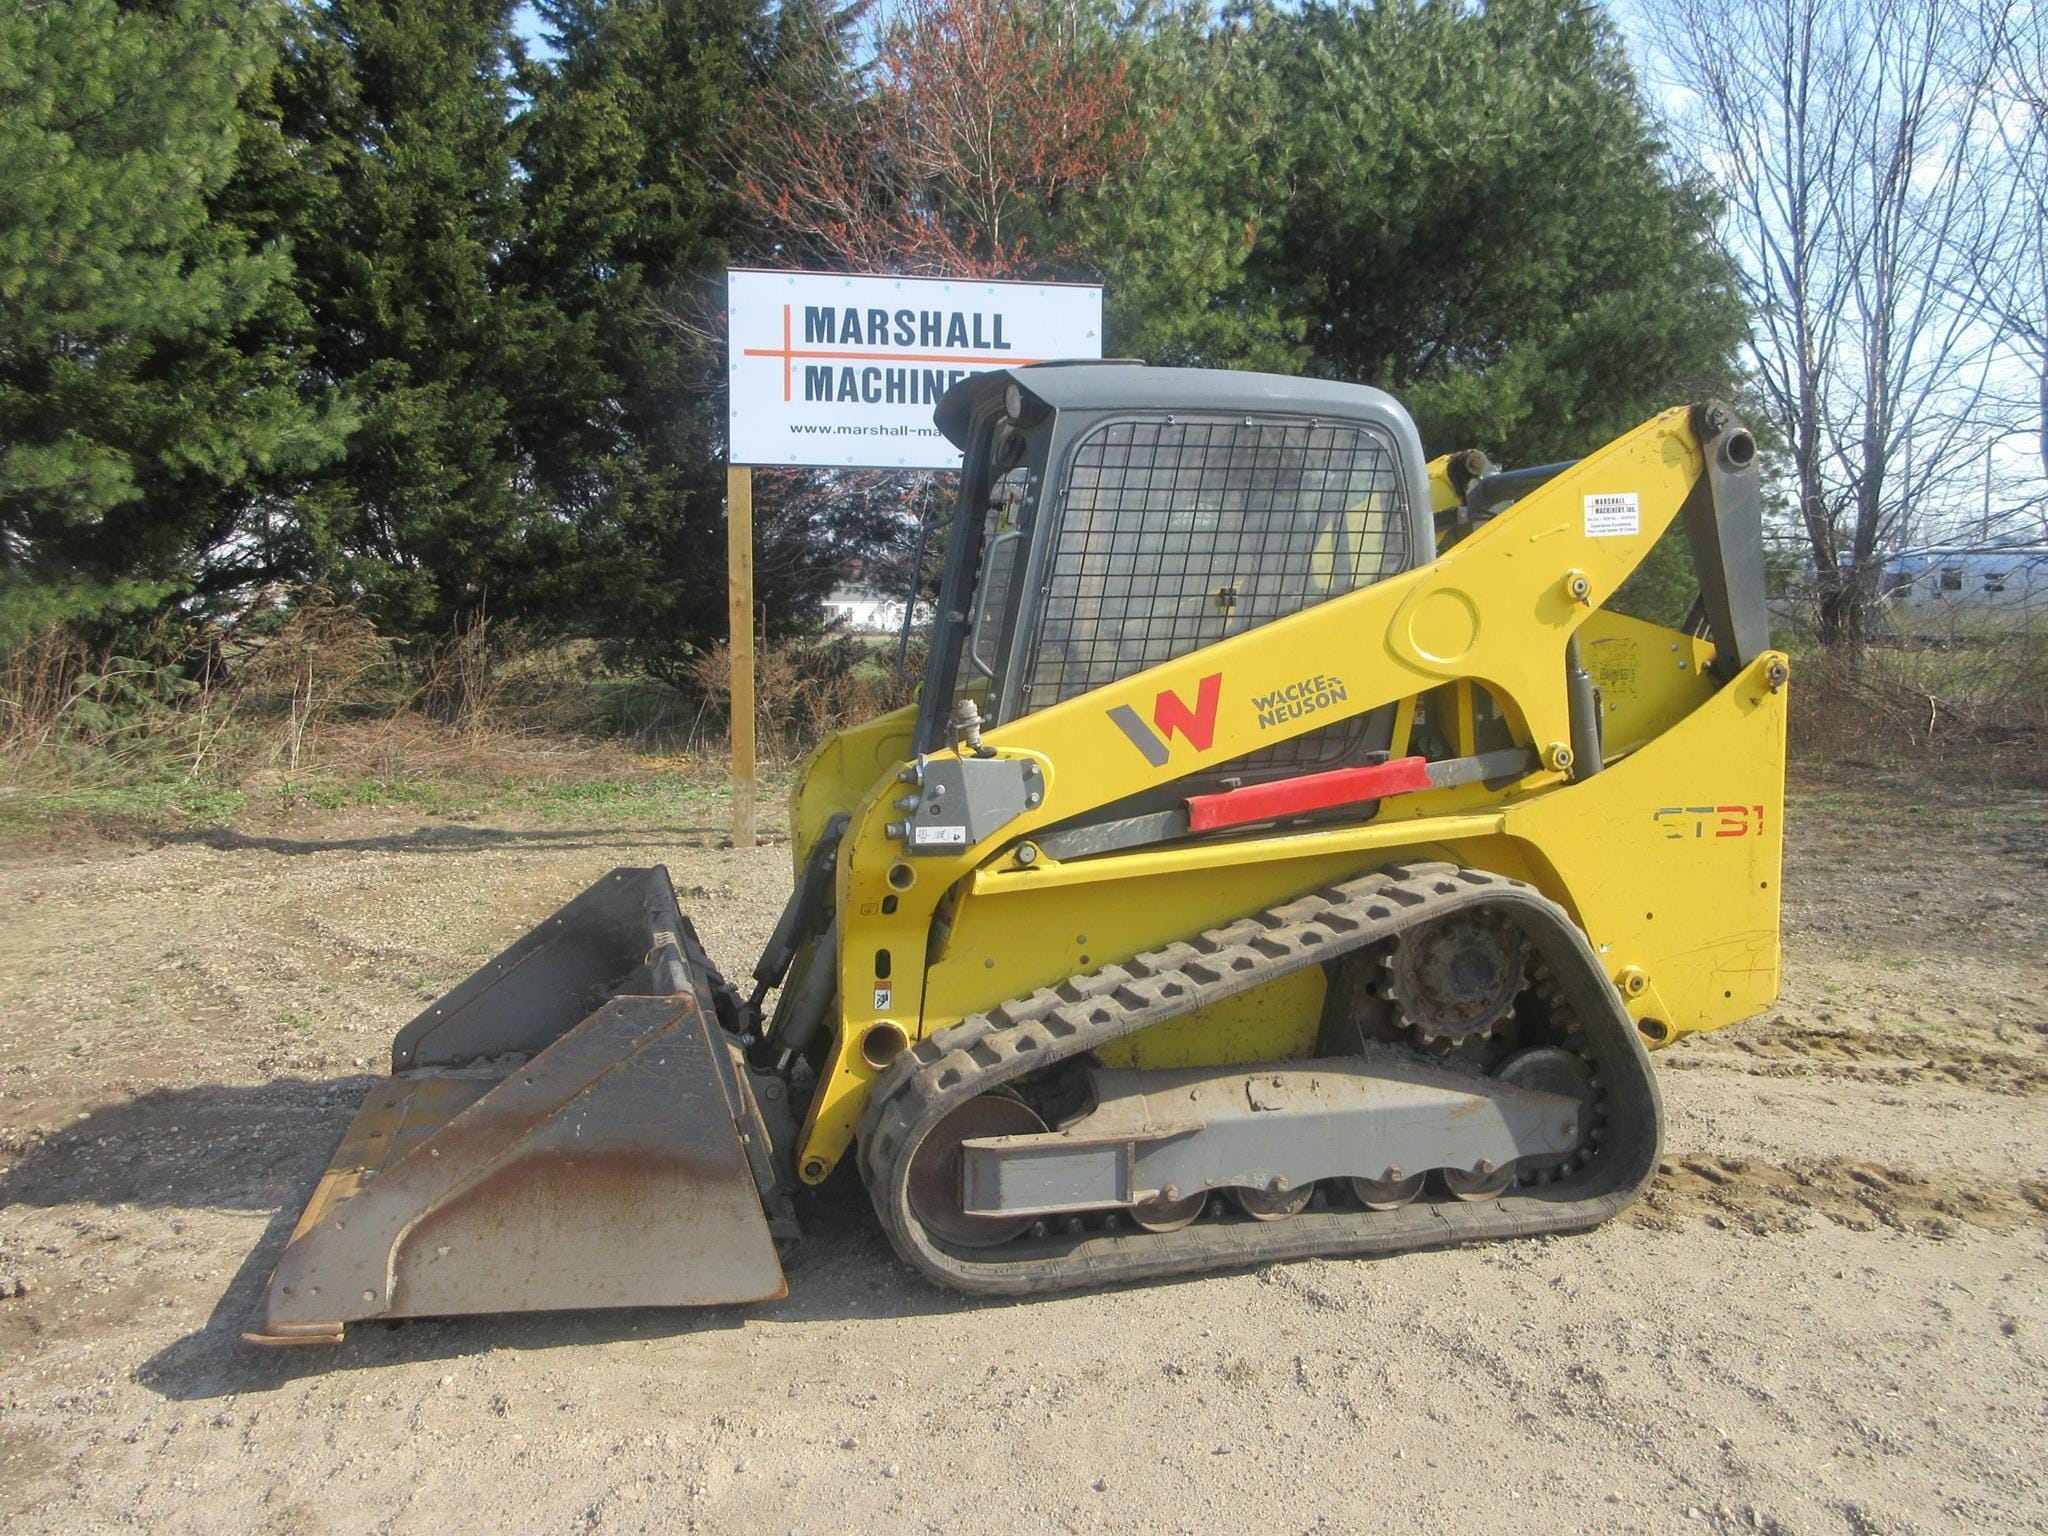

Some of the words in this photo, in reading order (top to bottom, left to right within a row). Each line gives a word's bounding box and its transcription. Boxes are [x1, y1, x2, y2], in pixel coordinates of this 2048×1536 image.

[804, 306, 1012, 350] MARSHALL
[804, 365, 985, 406] MACHIN
[1594, 497, 1625, 505] MARSHALL
[1257, 685, 1348, 730] NEUSON
